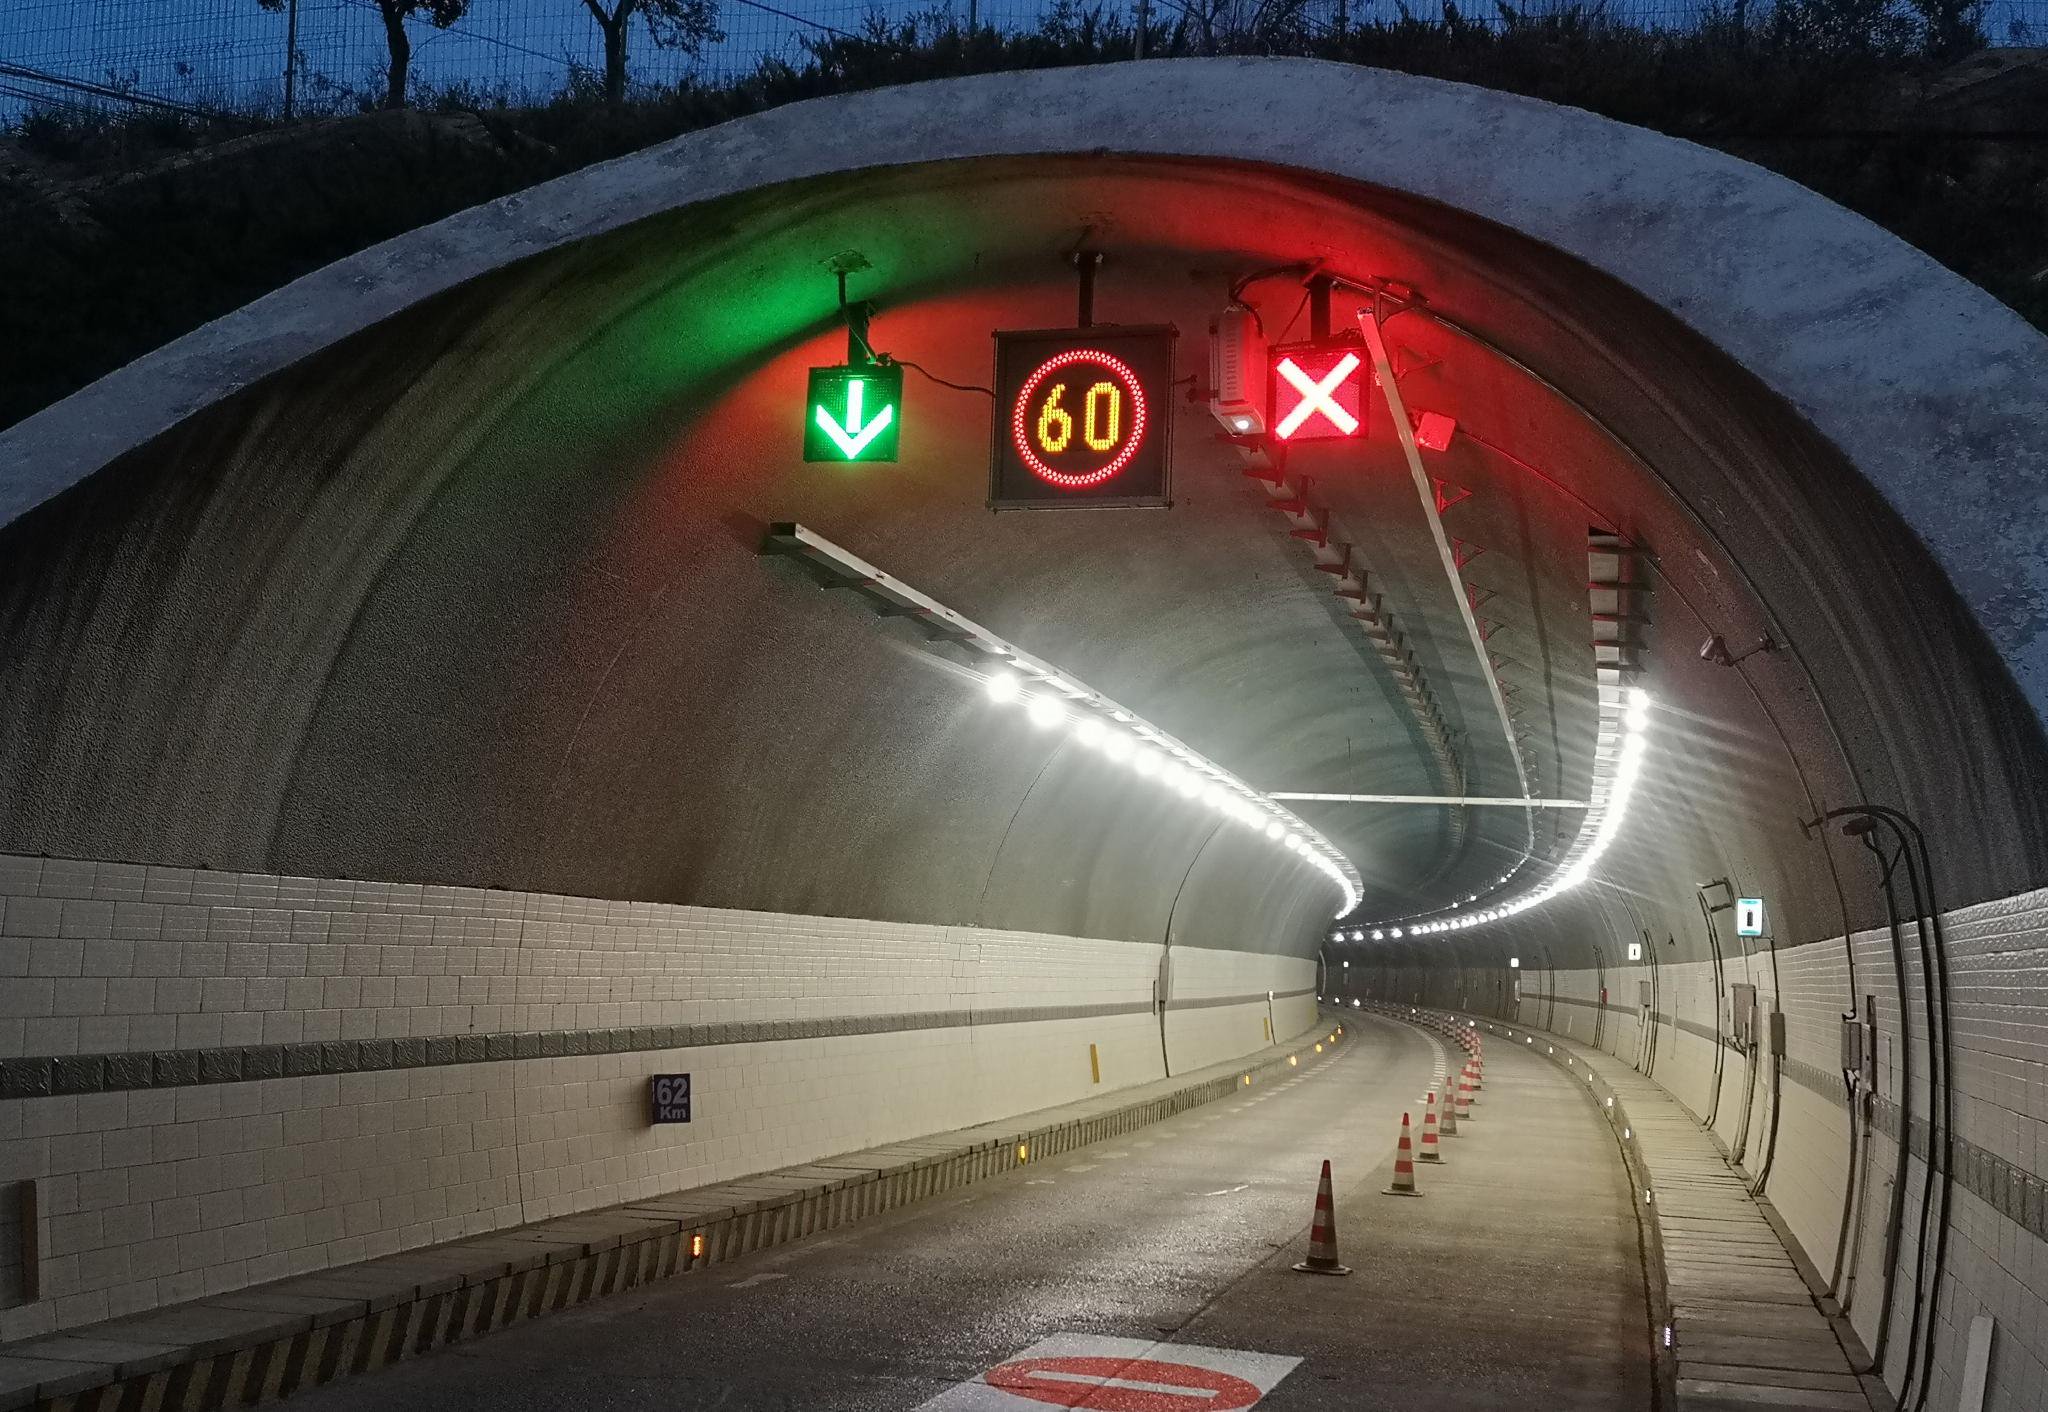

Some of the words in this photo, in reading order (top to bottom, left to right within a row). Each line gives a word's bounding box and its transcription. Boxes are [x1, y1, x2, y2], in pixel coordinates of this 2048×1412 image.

[1038, 382, 1120, 452] 60
[657, 1078, 688, 1105] 62
[660, 1106, 687, 1119] Km
